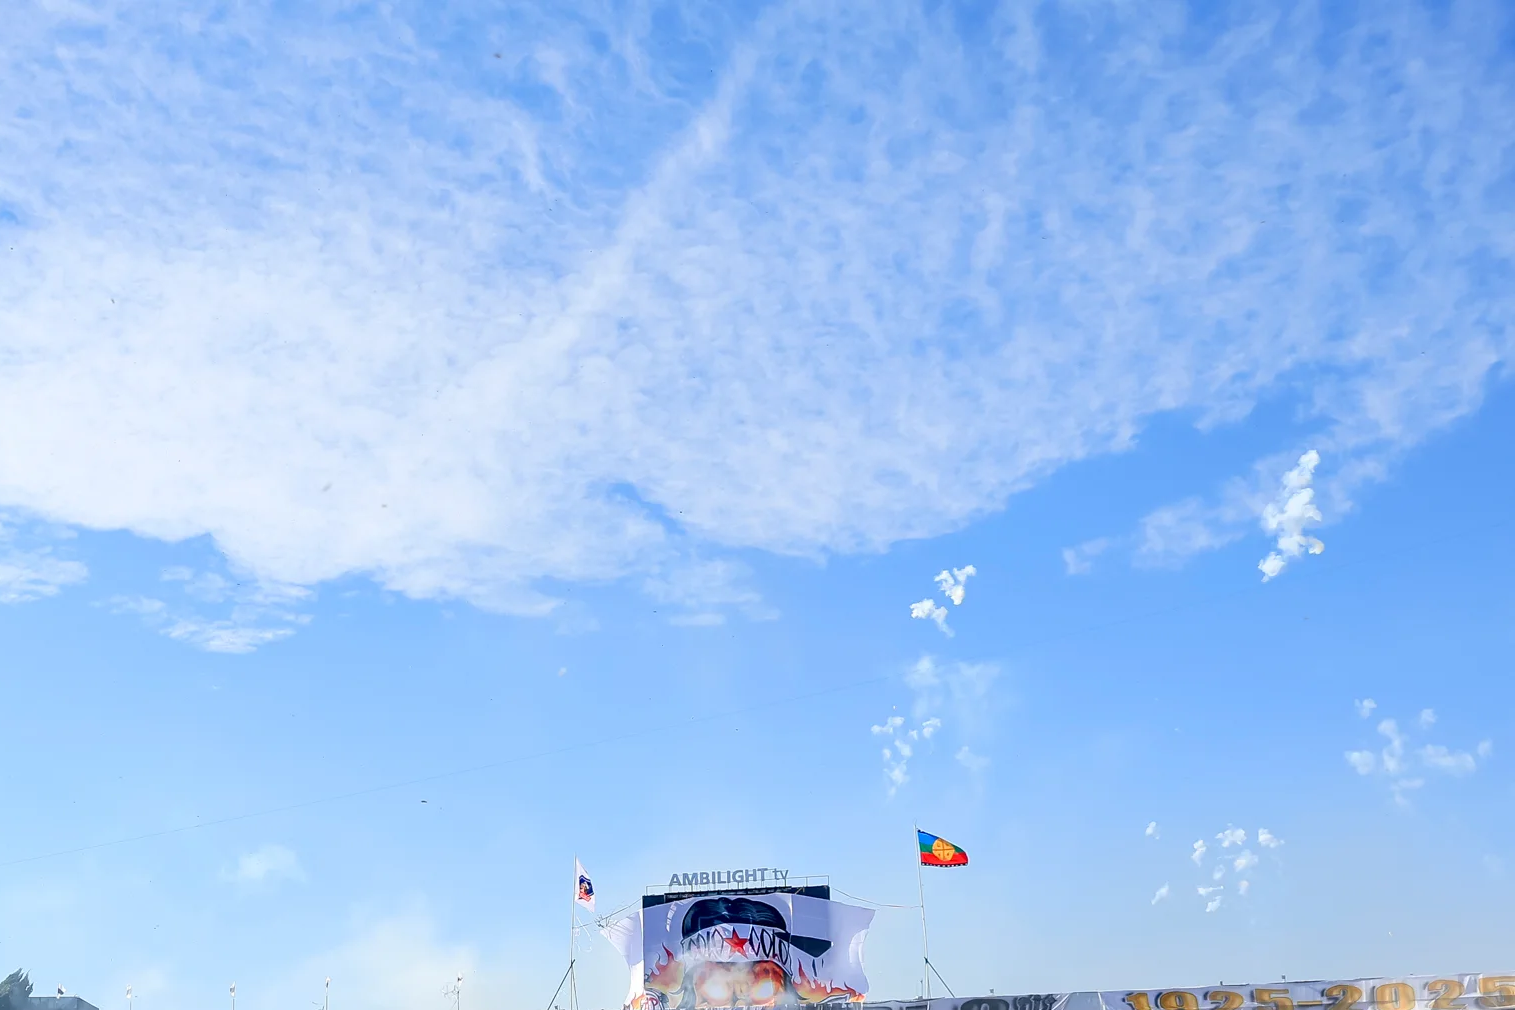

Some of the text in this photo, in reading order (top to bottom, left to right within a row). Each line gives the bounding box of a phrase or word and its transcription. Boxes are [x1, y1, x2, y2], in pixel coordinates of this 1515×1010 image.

[668, 868, 790, 887] AMBILIGHT tv
[748, 926, 791, 968] COLO
